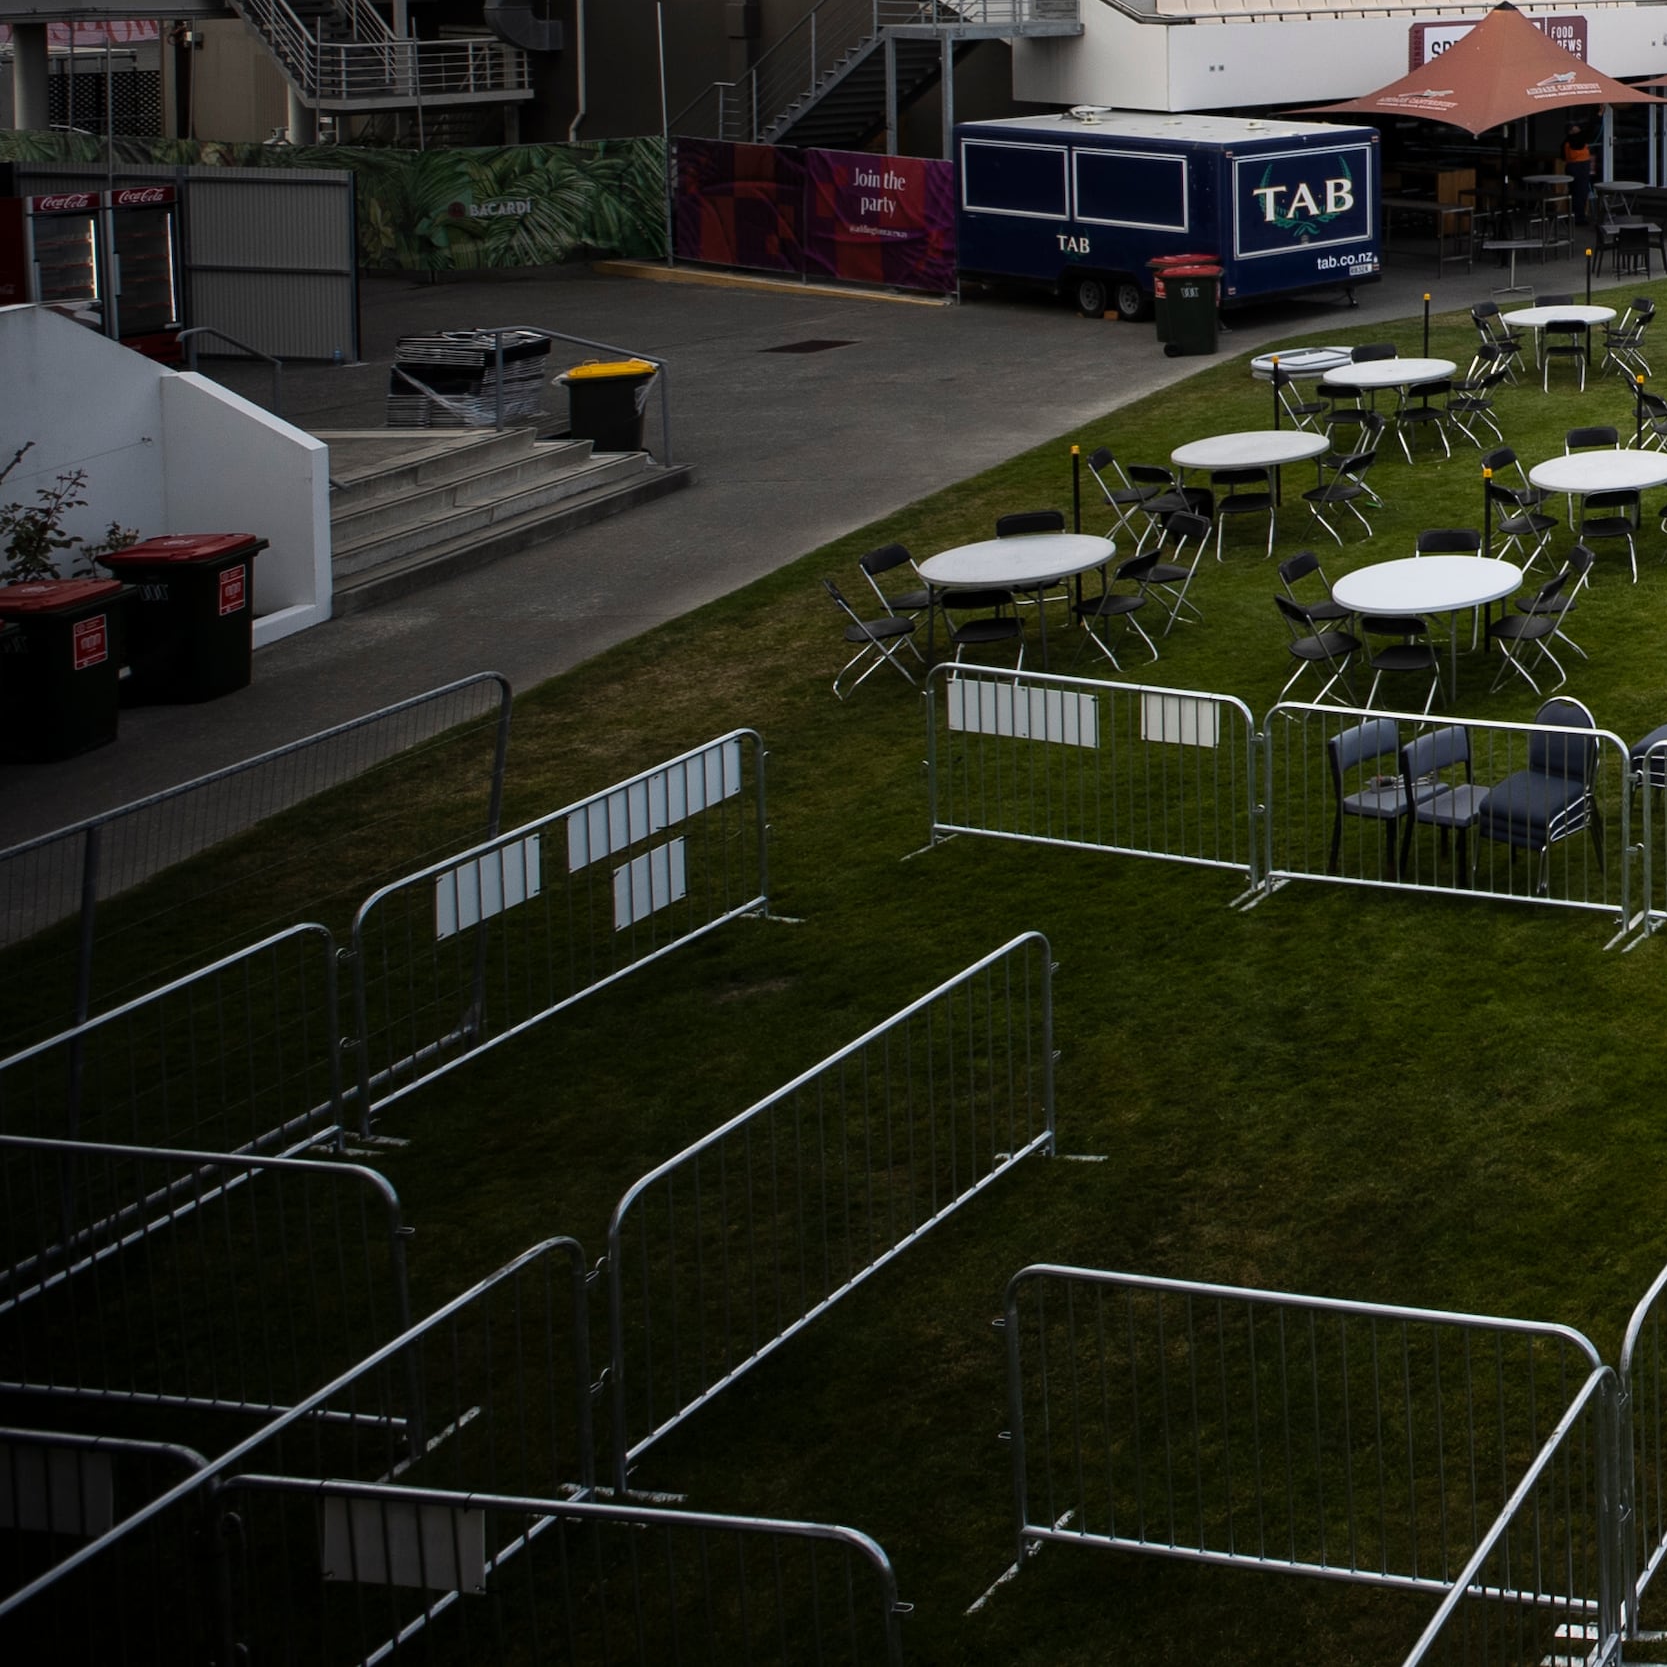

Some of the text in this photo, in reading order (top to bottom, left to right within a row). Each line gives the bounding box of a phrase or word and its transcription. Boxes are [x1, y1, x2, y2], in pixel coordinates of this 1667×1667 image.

[1551, 25, 1574, 39] FOOD
[853, 167, 906, 191] Join the
[861, 196, 896, 218] party
[1252, 178, 1354, 222] TAB
[1056, 234, 1090, 254] TAB
[1317, 252, 1373, 270] tab.co.nz
